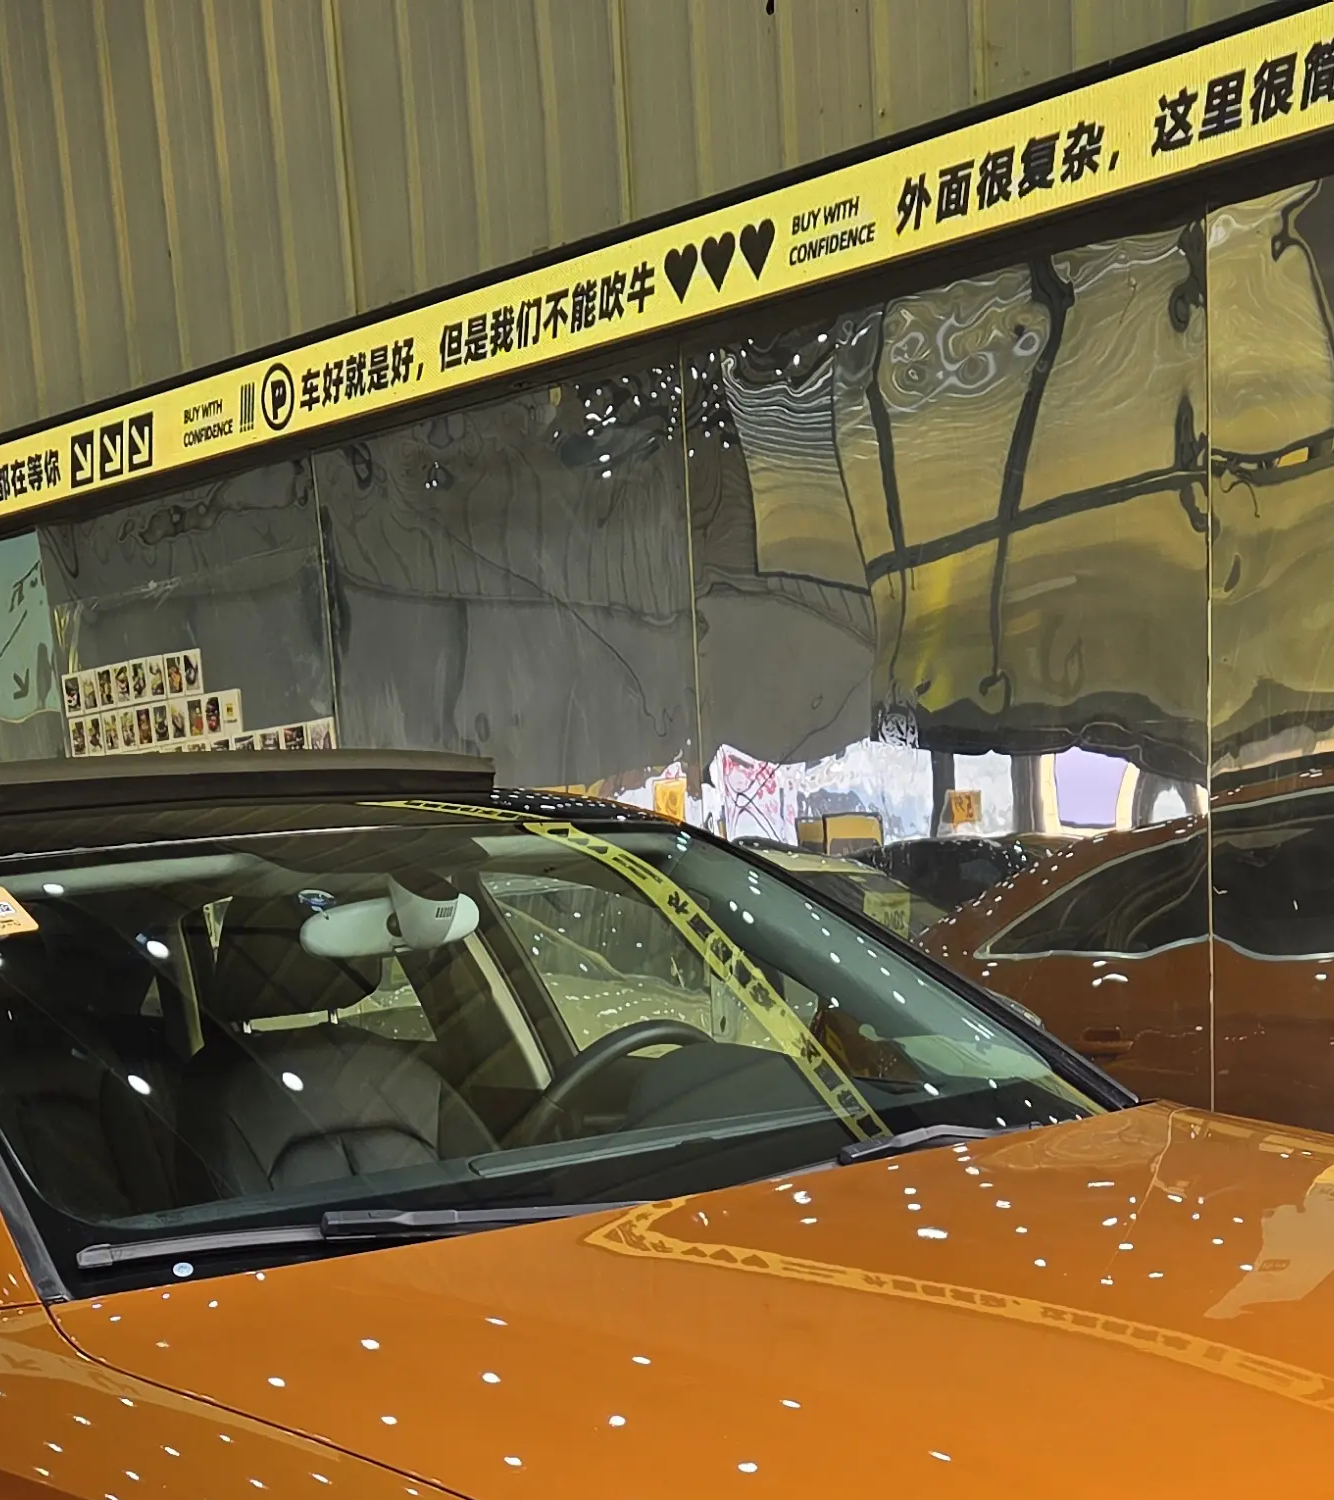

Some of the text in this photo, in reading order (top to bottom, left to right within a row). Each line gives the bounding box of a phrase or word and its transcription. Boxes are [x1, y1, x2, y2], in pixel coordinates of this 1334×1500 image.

[792, 196, 860, 235] BUY WITH
[789, 222, 876, 265] CONFIDENCE
[183, 399, 223, 424] BUY WITH
[183, 419, 233, 447] CONFIDENCE
